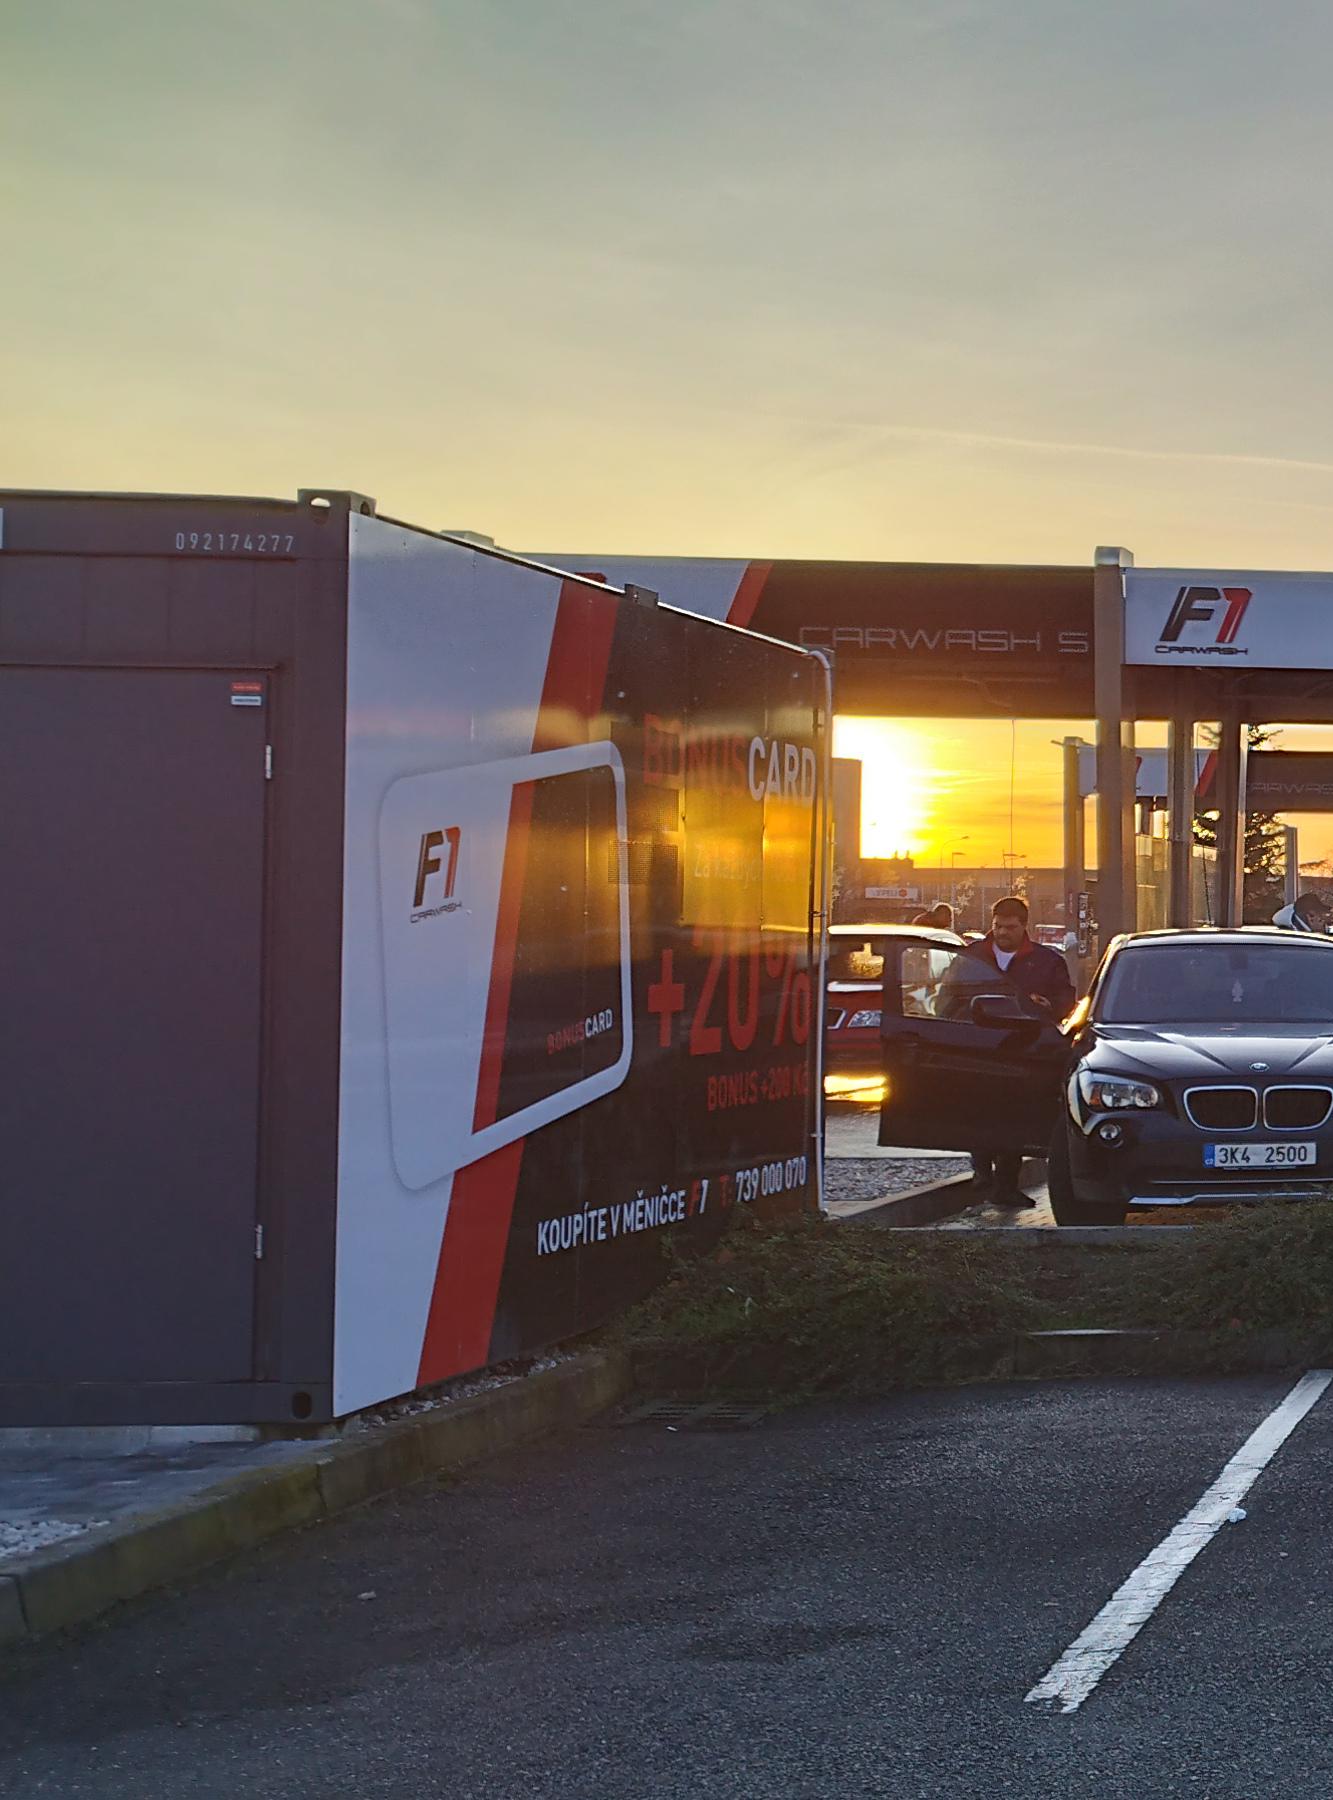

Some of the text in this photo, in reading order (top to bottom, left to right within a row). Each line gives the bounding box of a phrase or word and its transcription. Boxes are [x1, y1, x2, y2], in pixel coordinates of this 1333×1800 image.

[175, 532, 295, 552] 092174277
[1159, 586, 1253, 643] F1
[800, 626, 1040, 651] CARWASH
[1155, 645, 1249, 655] CARWASH
[412, 826, 461, 908] F1
[410, 901, 463, 924] CARWASH
[647, 918, 811, 1056] +20%
[547, 1008, 613, 1055] BONUSCARD
[707, 1070, 758, 1111] BONUS
[1219, 1145, 1308, 1164] 3K4 2500
[537, 1201, 607, 1256] KOUPÍTE
[611, 1205, 621, 1237] V
[622, 1184, 688, 1234] MĚNIČCE
[735, 1167, 760, 1202] 739
[761, 1159, 783, 1196] 000
[784, 1155, 808, 1190] 070
